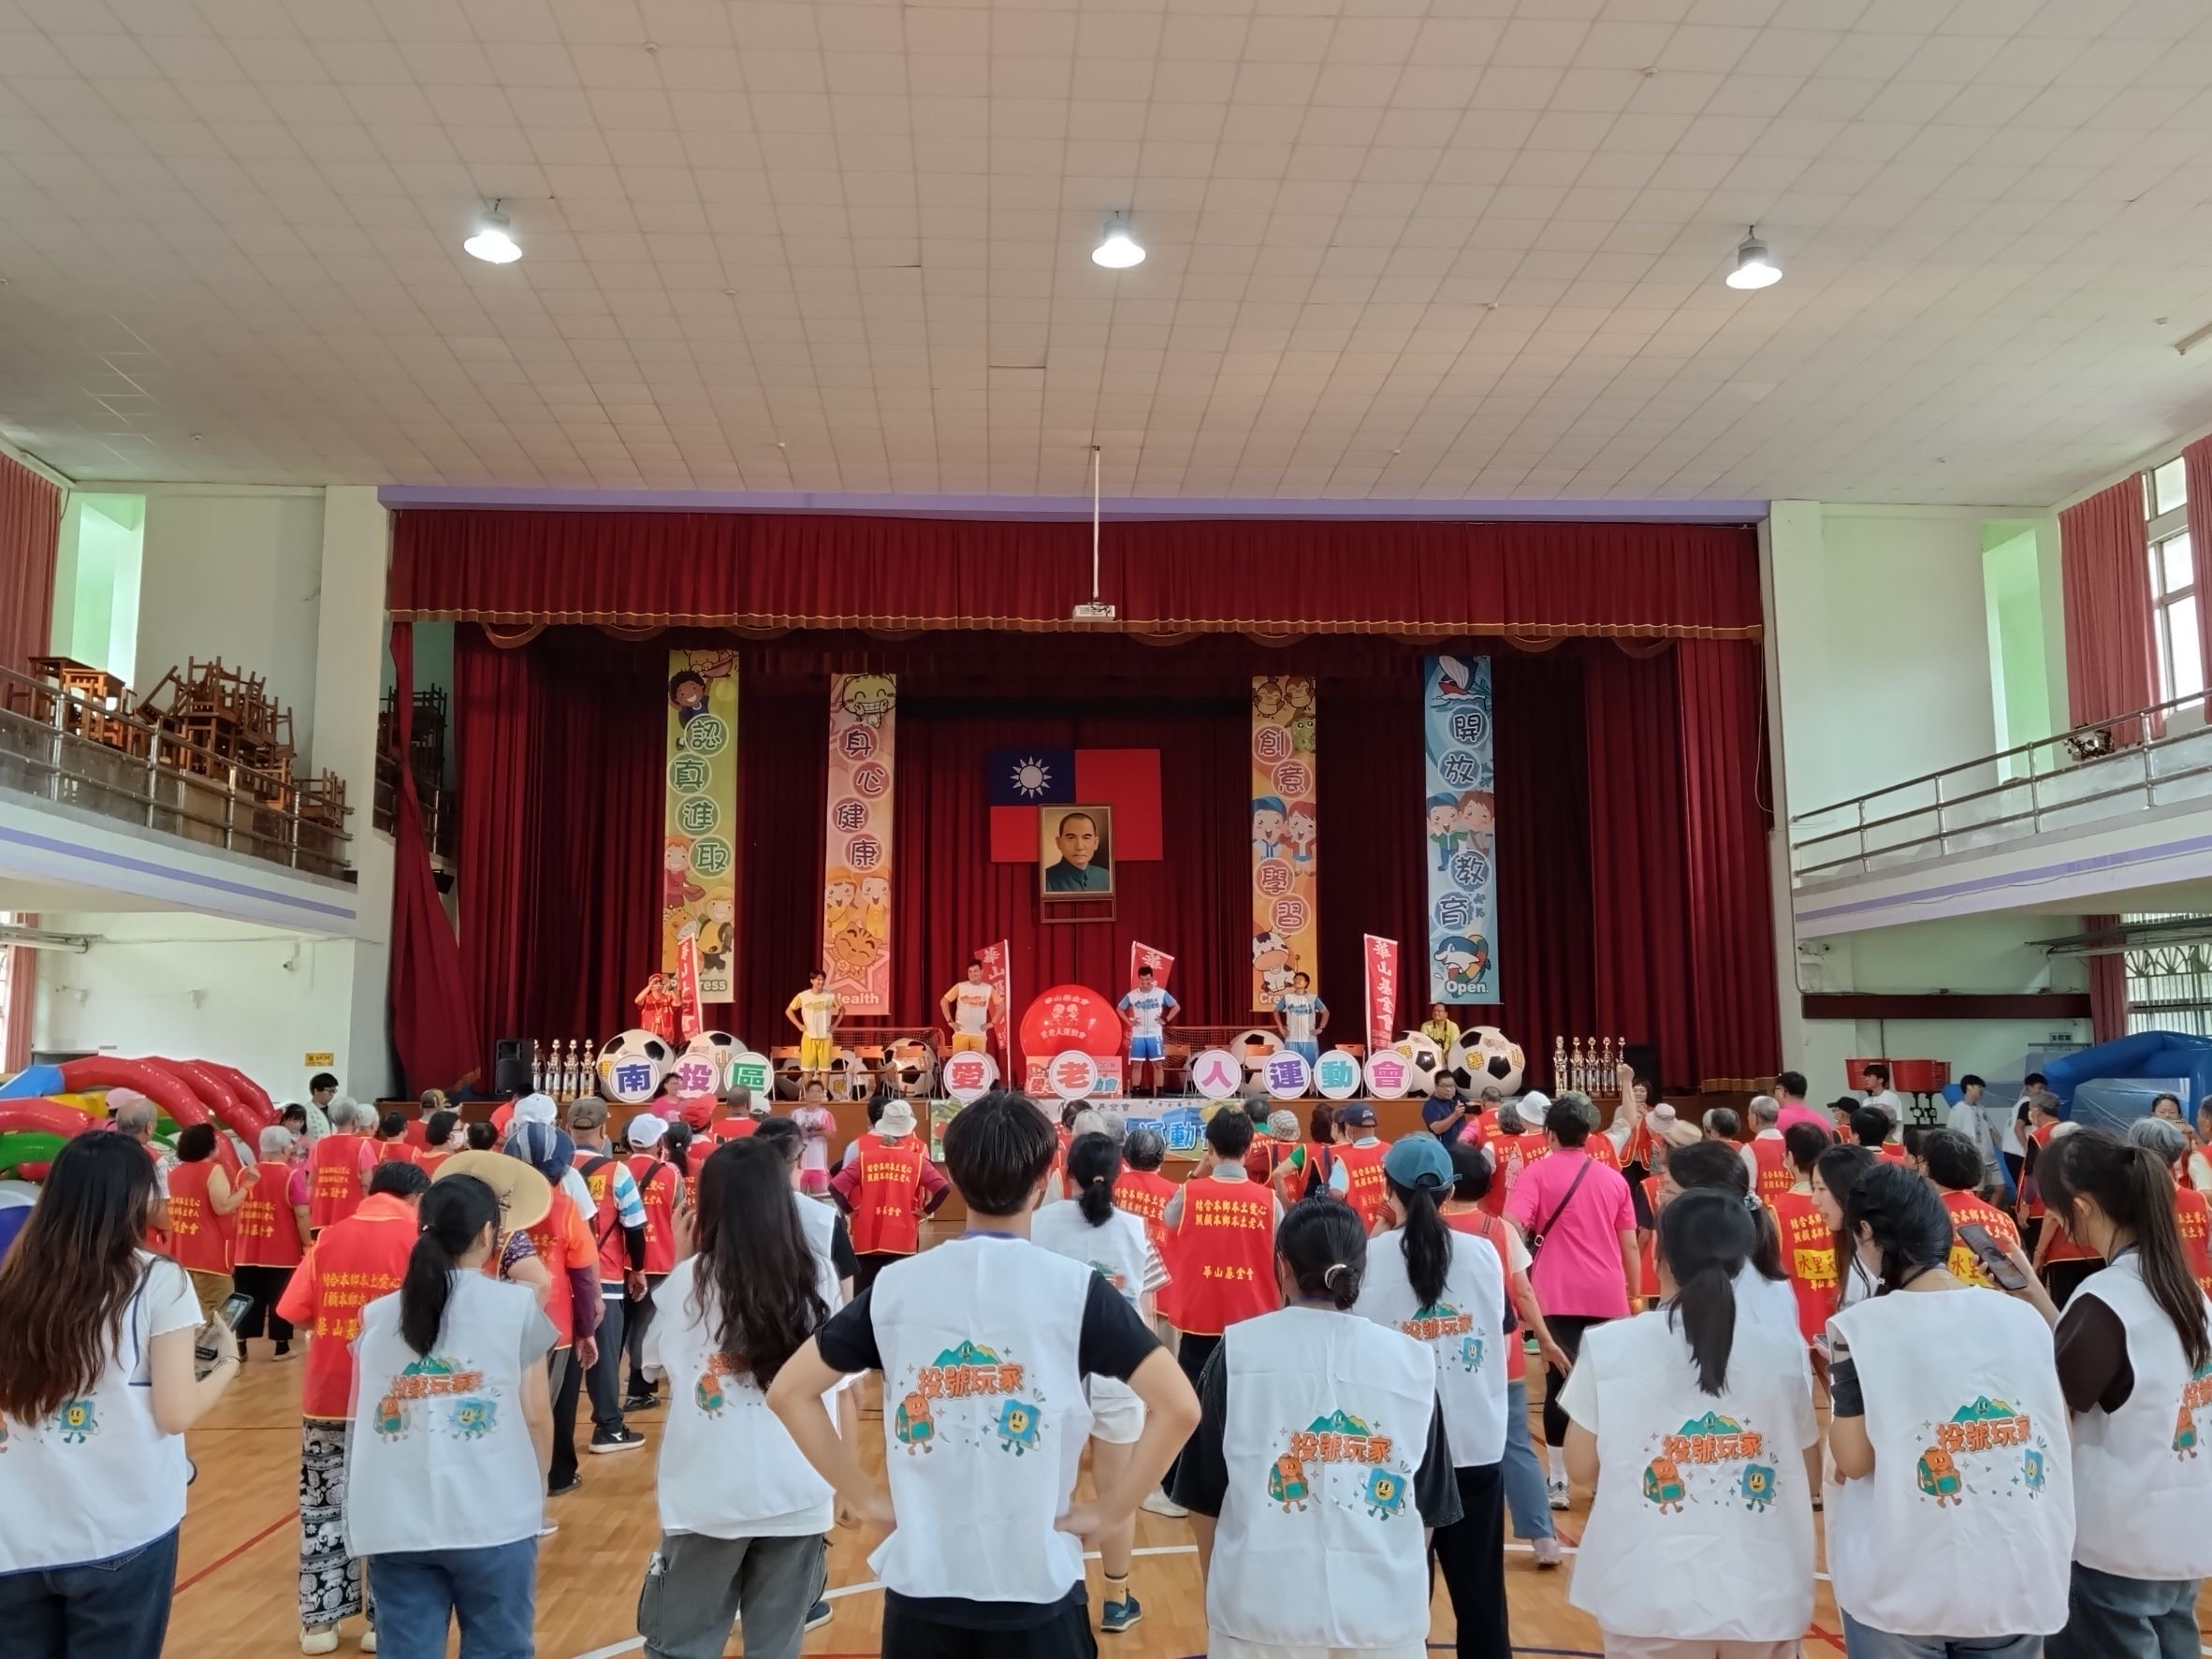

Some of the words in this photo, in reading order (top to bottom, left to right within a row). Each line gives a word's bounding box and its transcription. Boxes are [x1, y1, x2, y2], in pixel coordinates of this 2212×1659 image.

[674, 721, 728, 871] 認真進取
[837, 731, 885, 868] 身心健康
[616, 1062, 767, 1093] 南投區
[1195, 1199, 1268, 1216] 結合本鄉本土愛心
[1202, 1265, 1255, 1281] 華山基金會
[917, 1362, 1026, 1400] 投號玩家
[1289, 1431, 1392, 1464] 投號玩家
[1662, 1430, 1763, 1465] 投號玩家
[1936, 1414, 2031, 1454] 投號玩家
